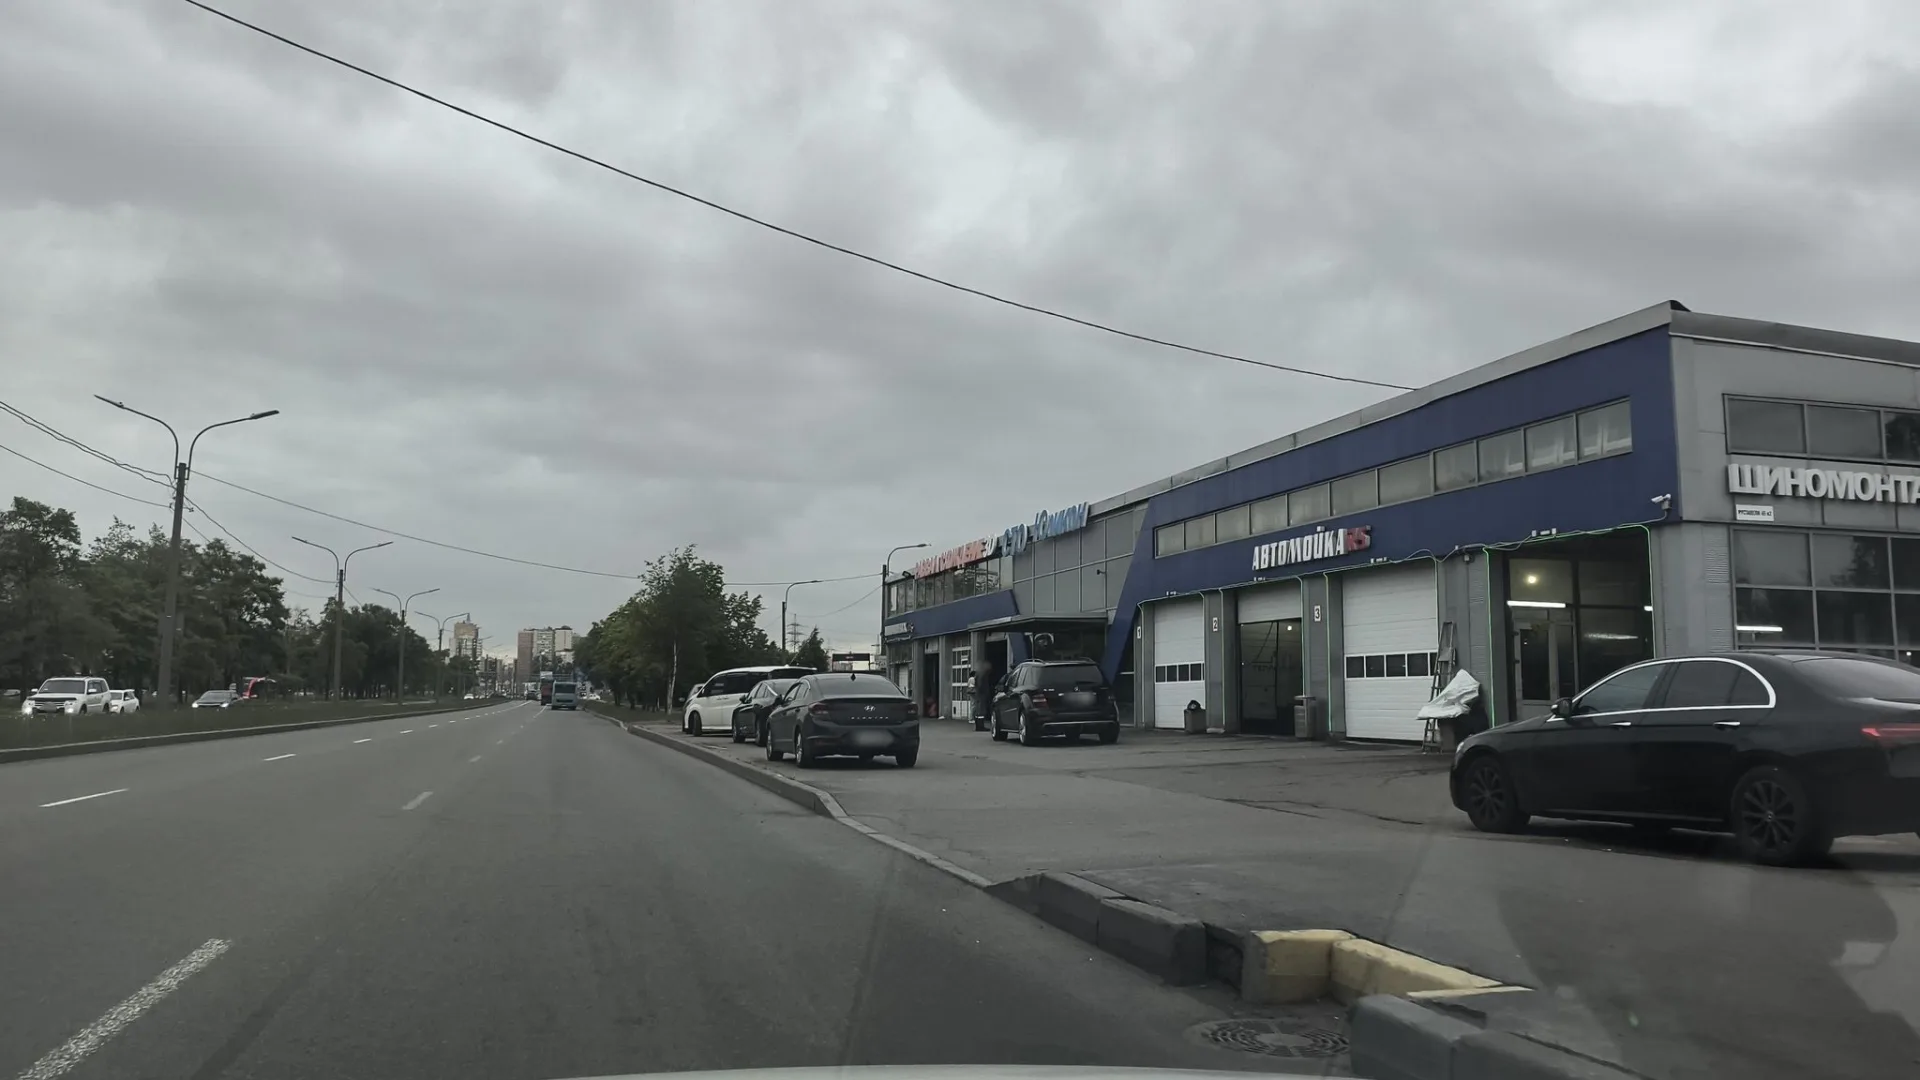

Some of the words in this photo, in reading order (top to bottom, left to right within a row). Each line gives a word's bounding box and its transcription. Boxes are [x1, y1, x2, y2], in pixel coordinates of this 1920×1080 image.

[1252, 525, 1347, 571] АВТОМОЙКА
[1314, 607, 1321, 620] 3
[1213, 619, 1218, 630] 2
